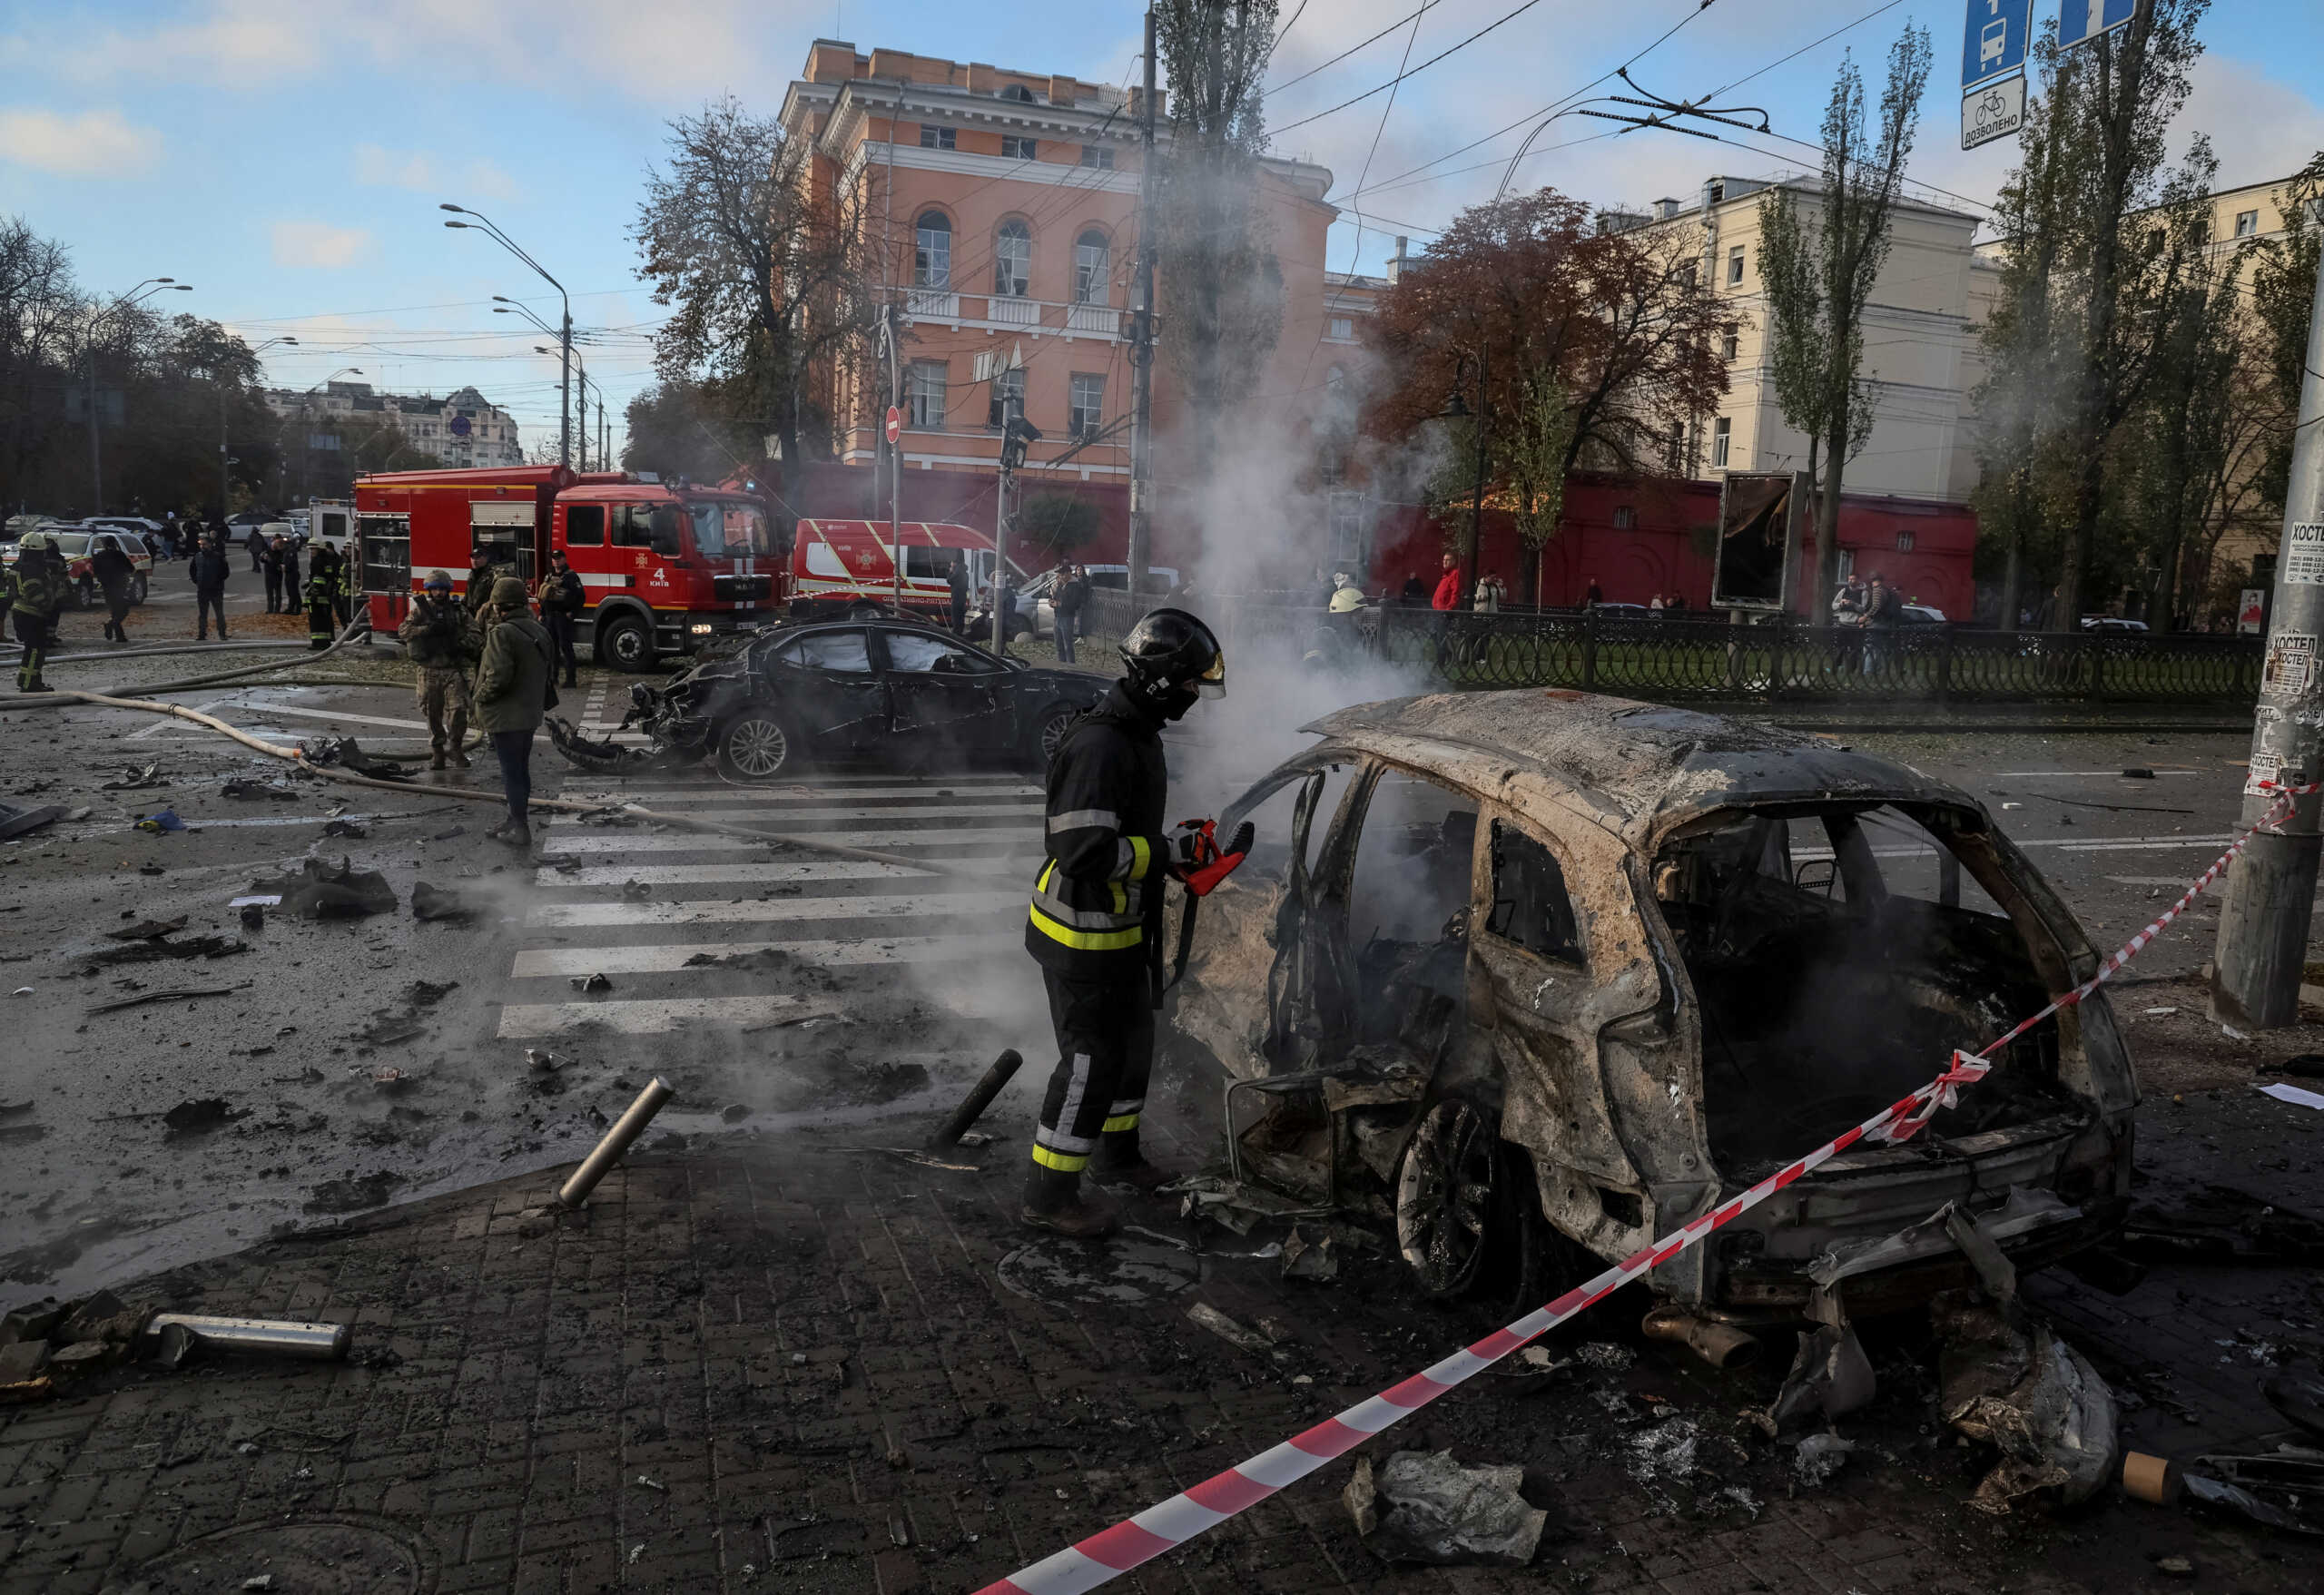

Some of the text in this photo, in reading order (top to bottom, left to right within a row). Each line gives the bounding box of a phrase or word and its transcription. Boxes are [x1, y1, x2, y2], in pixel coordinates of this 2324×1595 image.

[1965, 114, 2018, 145] ДОЗВОЛЕНО
[654, 567, 665, 579] 4
[649, 579, 669, 587] КИЇВ
[2276, 653, 2309, 665] ХОСТЕЛ
